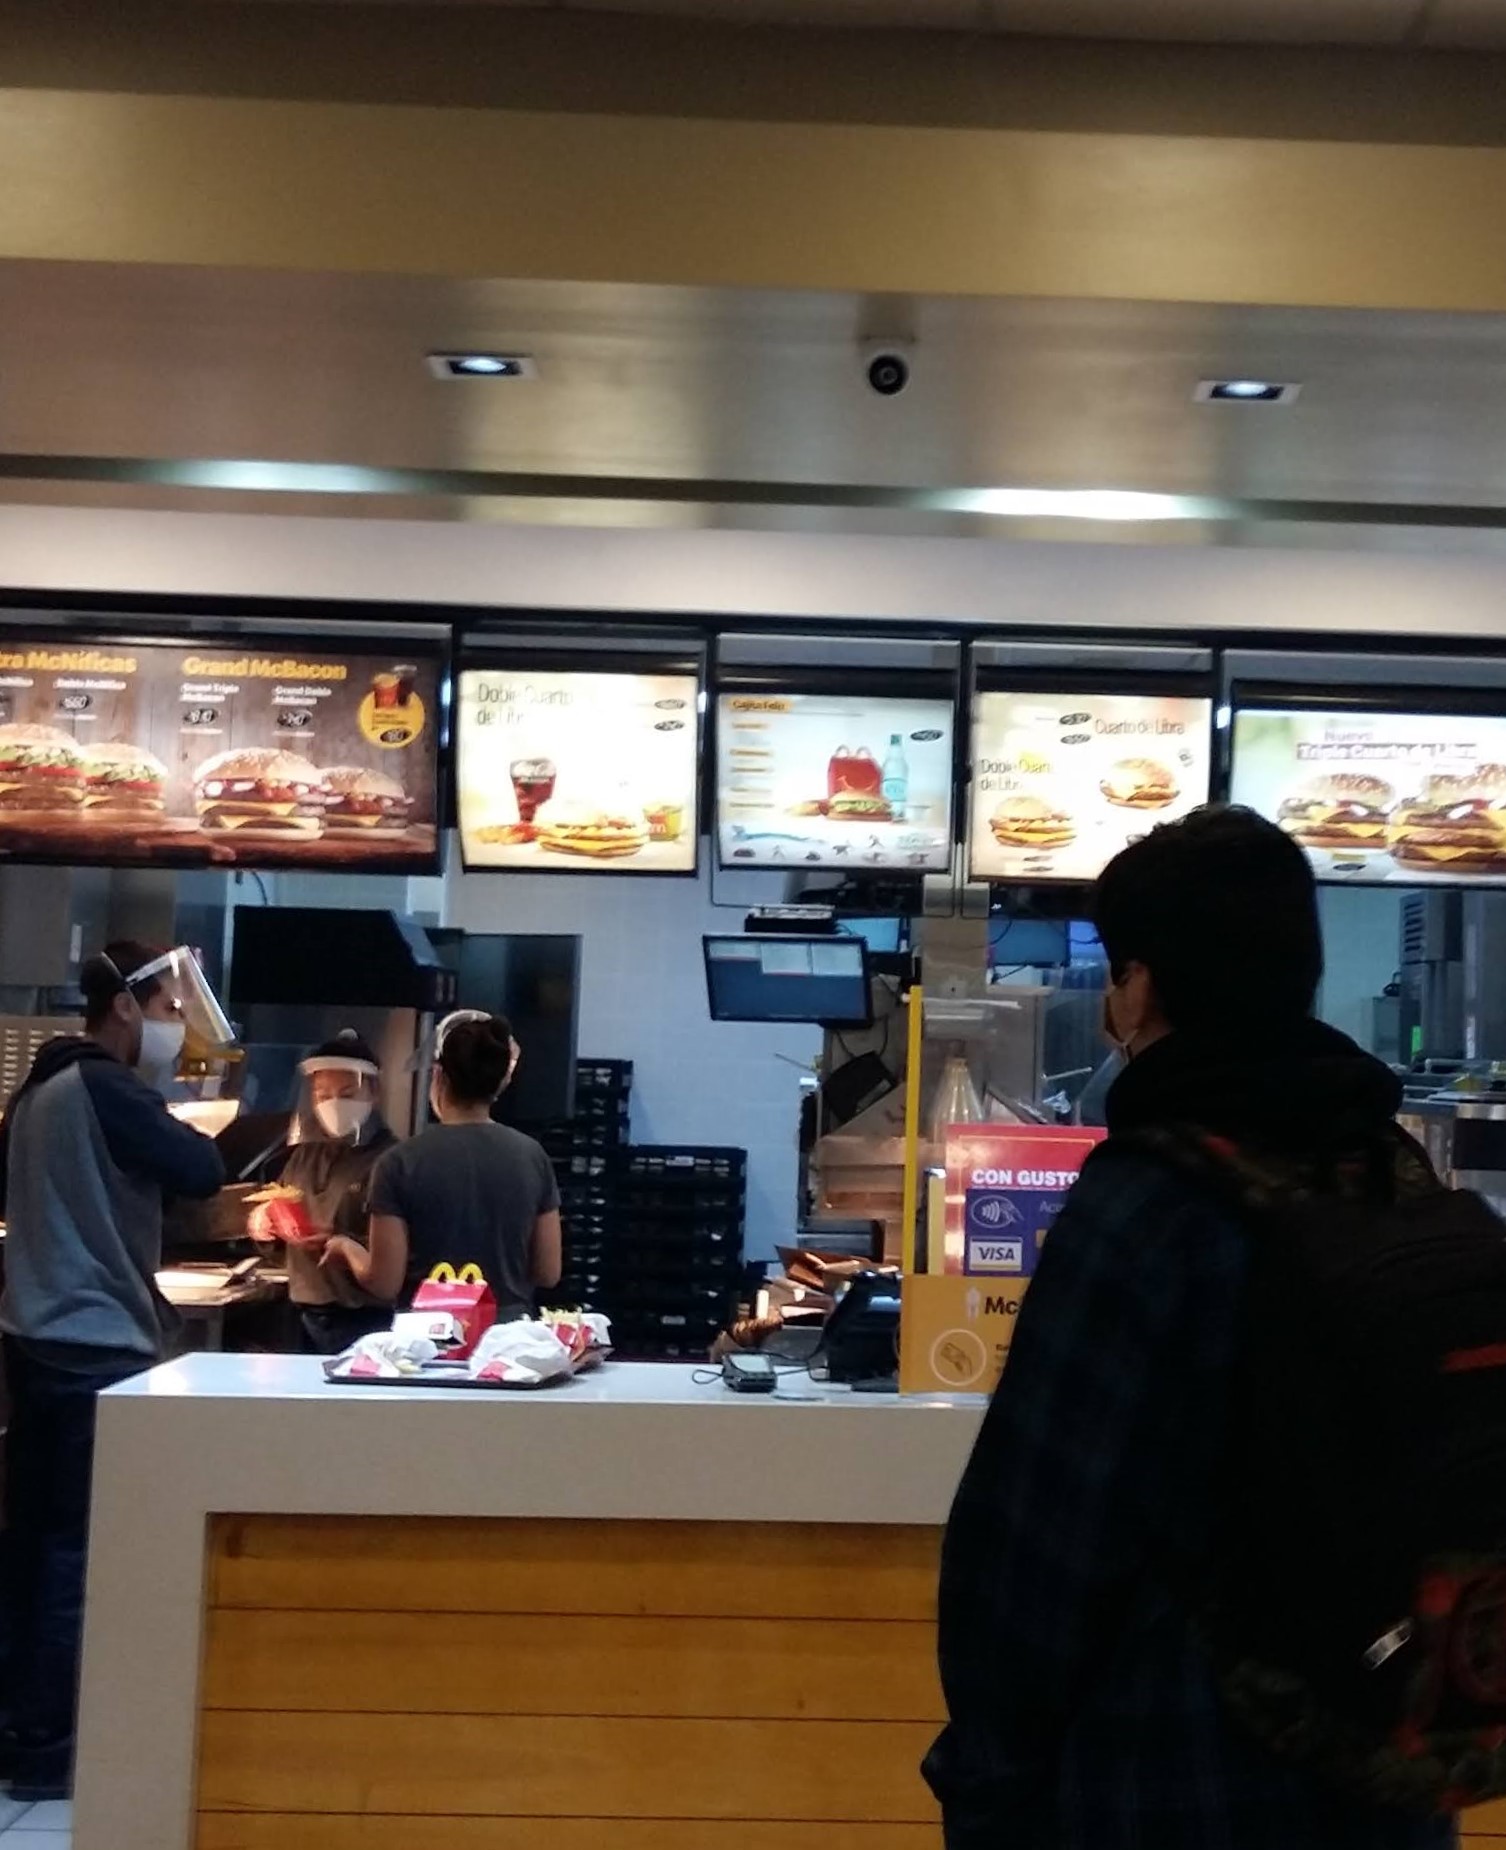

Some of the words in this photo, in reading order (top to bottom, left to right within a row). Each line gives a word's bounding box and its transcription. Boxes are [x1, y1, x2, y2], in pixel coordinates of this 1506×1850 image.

[181, 656, 249, 677] Grand
[250, 659, 347, 681] McBacon
[972, 1169, 1013, 1185] CON
[978, 1246, 1016, 1262] VISA
